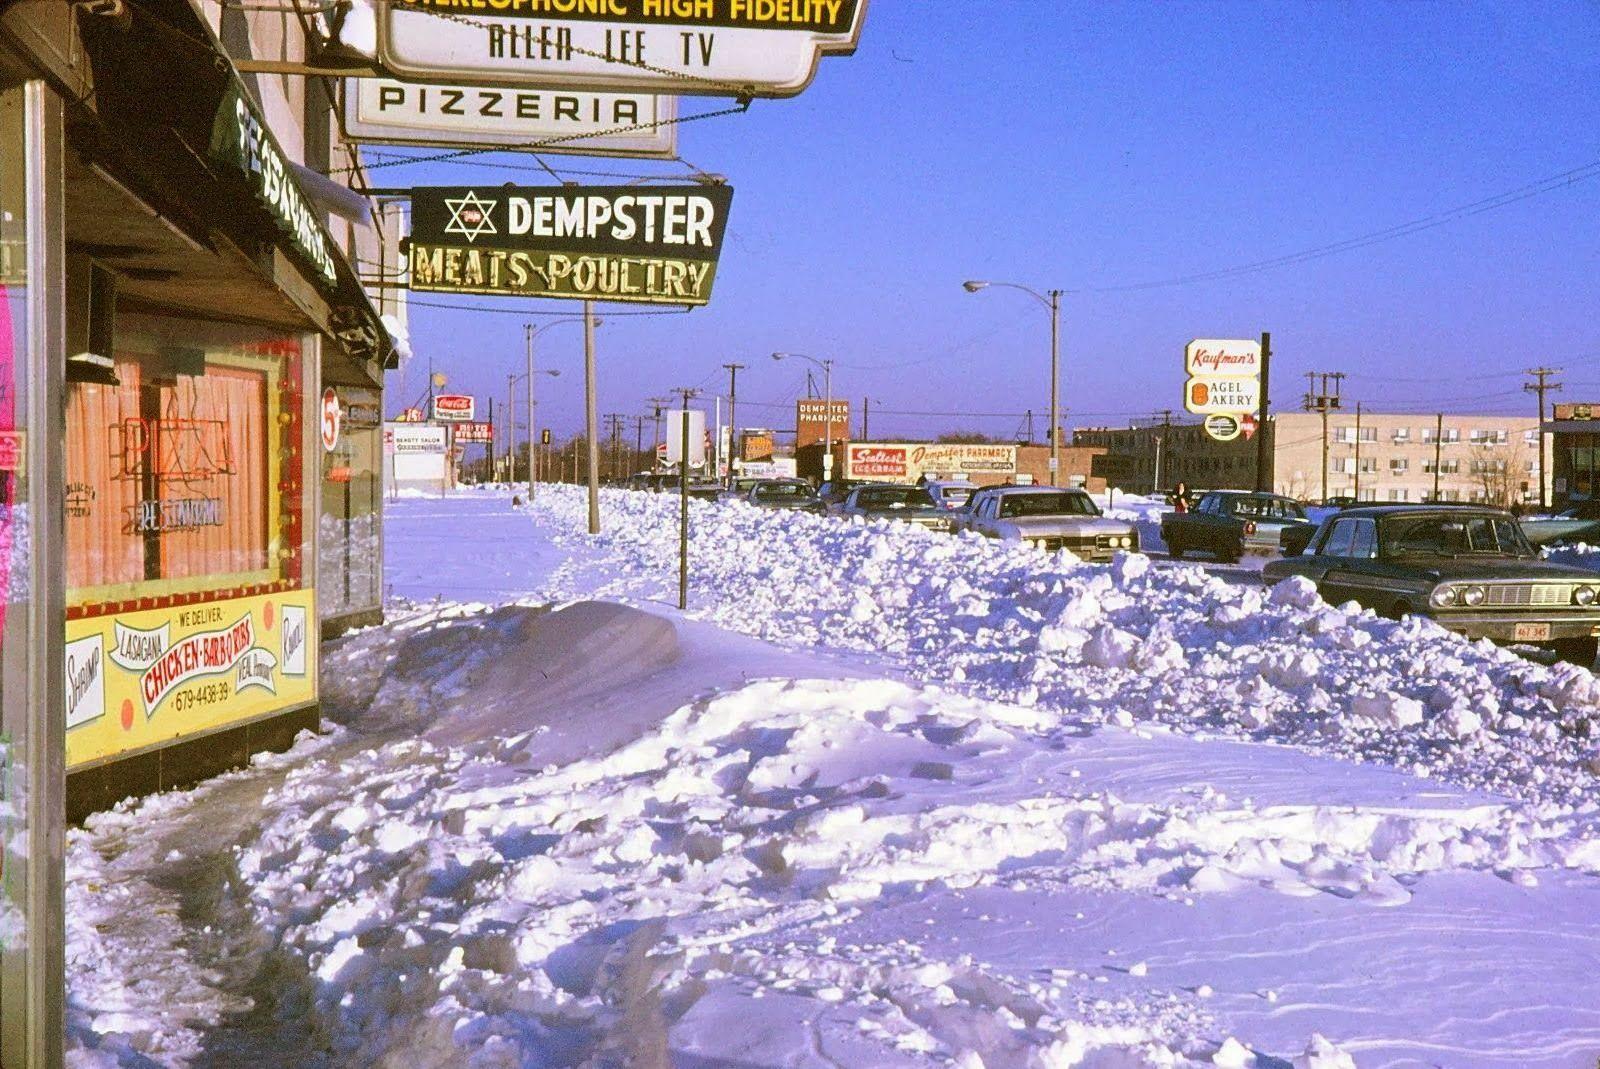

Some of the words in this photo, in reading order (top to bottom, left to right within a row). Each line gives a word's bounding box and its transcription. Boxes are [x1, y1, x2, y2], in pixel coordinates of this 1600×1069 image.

[643, 0, 715, 19] HIGH
[730, 0, 840, 25] FIDELITY
[489, 24, 573, 61] ALLEN
[606, 29, 647, 65] LEE
[680, 33, 715, 67] TV
[379, 87, 638, 124] PIZZERIA
[509, 196, 714, 247] DEMPSTER
[416, 247, 528, 288] MEATS
[548, 254, 711, 298] POULTRY
[1192, 348, 1255, 371] Kaufman's
[800, 404, 848, 413] DEMPTER
[179, 613, 190, 627] WE
[192, 607, 223, 625] DELIVER
[144, 638, 200, 704] CHICKEN
